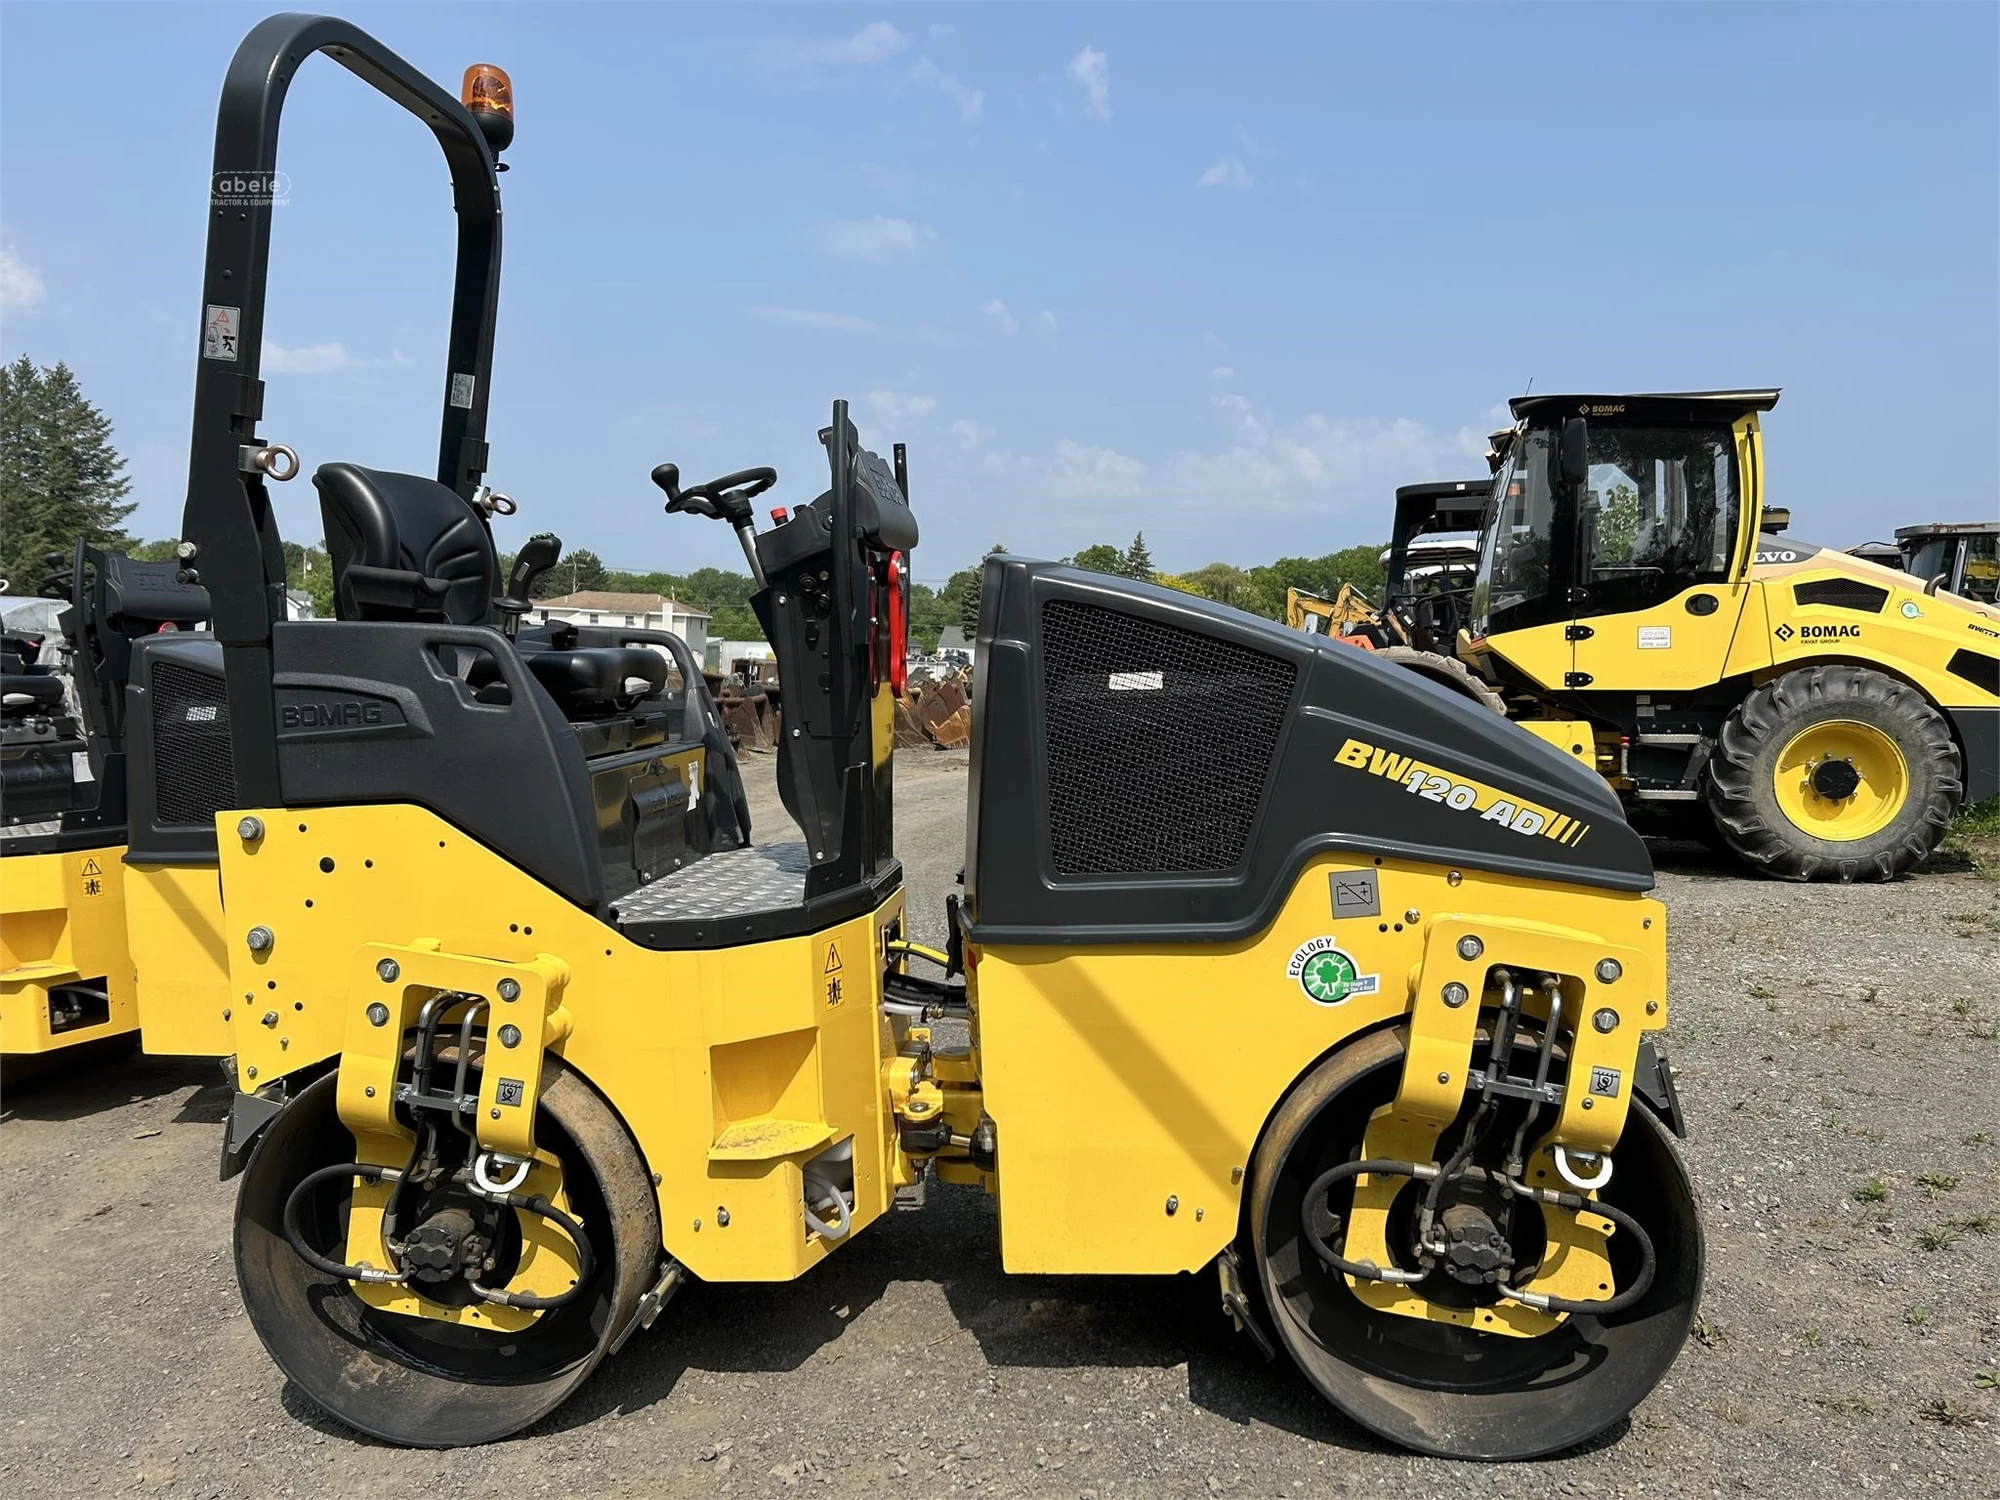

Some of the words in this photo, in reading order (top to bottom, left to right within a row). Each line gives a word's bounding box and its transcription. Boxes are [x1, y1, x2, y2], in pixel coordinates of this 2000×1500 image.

[1592, 404, 1626, 413] BOMAG
[1800, 624, 1860, 638] BOMAG
[281, 701, 383, 728] BOMAG
[1480, 800, 1545, 837] AD
[1289, 937, 1332, 977] ECOLOGY
